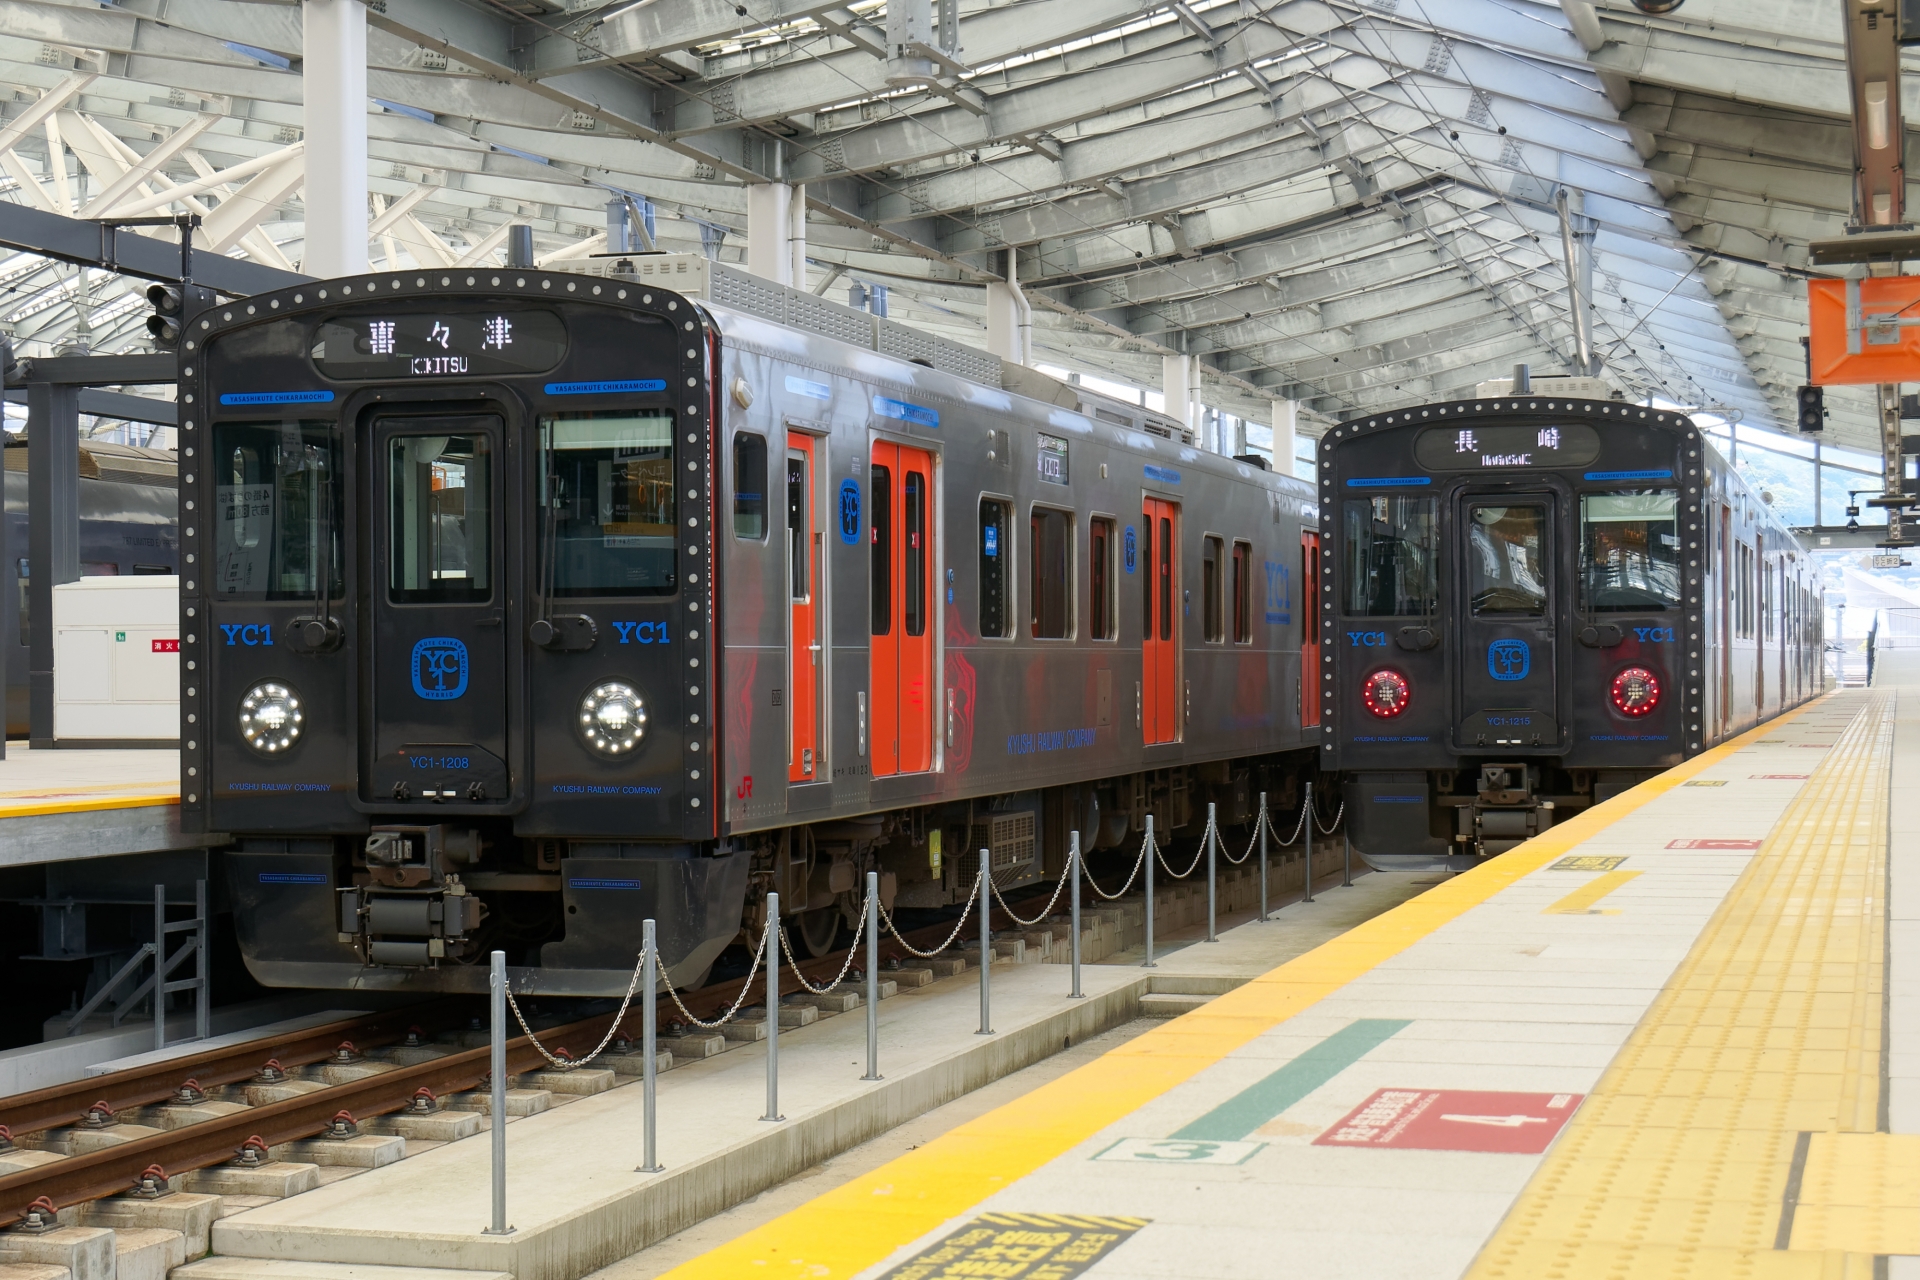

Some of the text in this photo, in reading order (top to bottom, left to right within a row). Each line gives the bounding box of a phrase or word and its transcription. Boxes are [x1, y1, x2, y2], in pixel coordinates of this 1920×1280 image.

[369, 316, 512, 355] 喜々津
[554, 382, 656, 392] YASASHIKUTE CHIKARAMOCHI
[229, 393, 325, 403] YASASHIKUTE CHIKARAMOCHI
[1454, 426, 1561, 453] 長崎
[133, 537, 155, 547] LIMITED
[1265, 561, 1291, 609] YC1
[220, 624, 274, 646] YC1
[612, 621, 670, 644] YC1
[1346, 631, 1387, 647] YC1
[1633, 627, 1675, 643] YC1
[154, 641, 180, 650] 消火
[421, 650, 459, 674] YC
[1486, 717, 1531, 726] YC1-1215
[1007, 727, 1098, 755] KYUSHU RAILWAY COMPANY
[409, 756, 469, 769] YC1-1208
[229, 782, 331, 792] KYUSHU RAILWAY COMPANY
[552, 785, 662, 795] KYUSHU RAILWAY COMPANY
[737, 775, 753, 799] JR
[1439, 1113, 1547, 1127] 4
